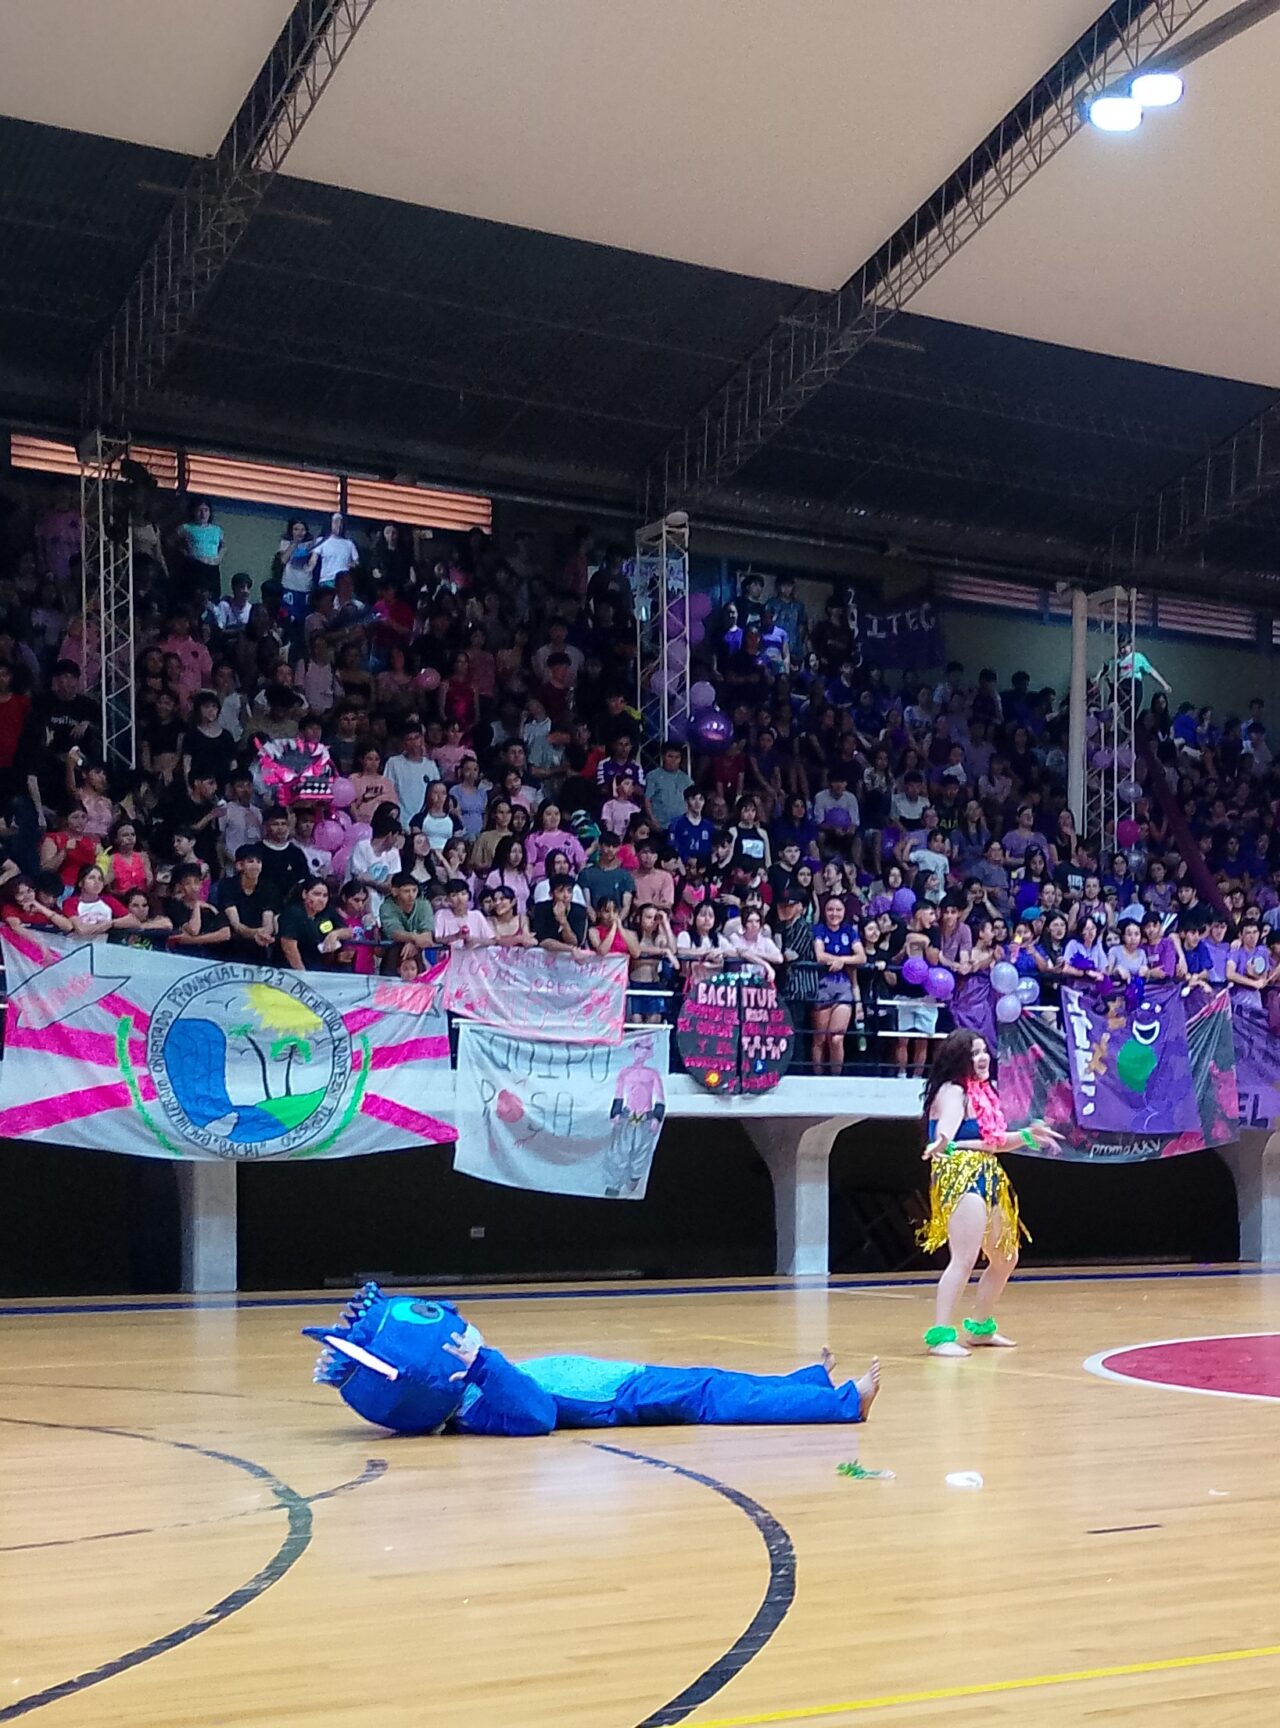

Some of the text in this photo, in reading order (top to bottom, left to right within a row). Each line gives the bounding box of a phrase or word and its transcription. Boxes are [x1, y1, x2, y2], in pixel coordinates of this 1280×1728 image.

[167, 965, 240, 1008] PROVINCIAL
[697, 982, 737, 1008] BACH
[470, 1029, 611, 1082] QUIPO
[1239, 1093, 1269, 1129] EL
